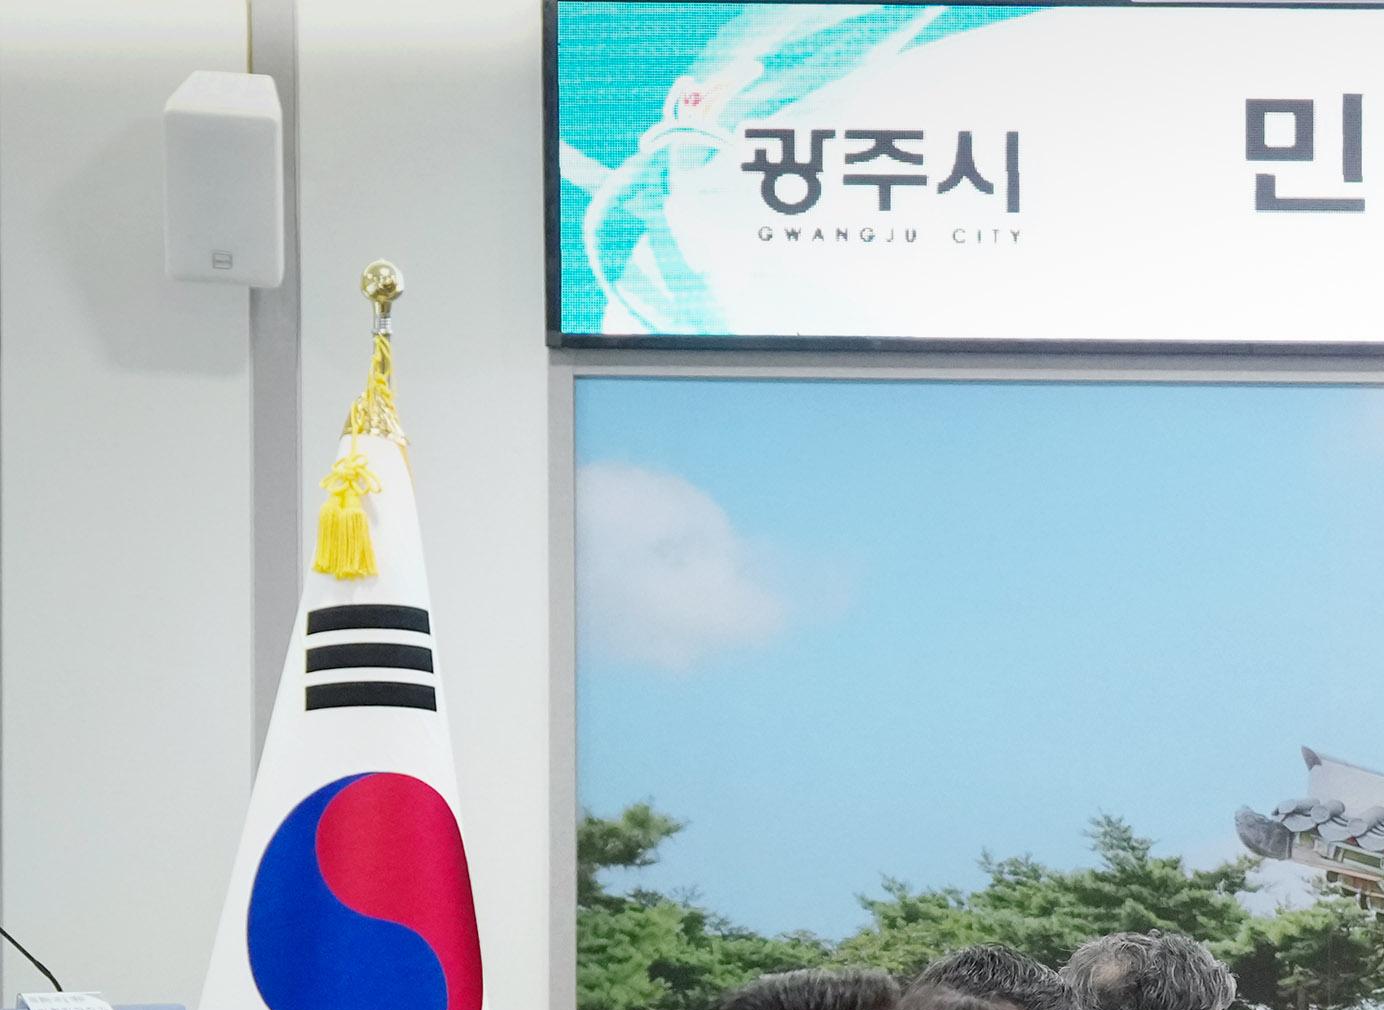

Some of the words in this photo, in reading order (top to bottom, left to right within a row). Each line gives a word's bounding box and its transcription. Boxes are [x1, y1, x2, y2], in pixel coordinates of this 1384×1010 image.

[741, 128, 1020, 216] 광주시
[758, 226, 918, 243] GWANGJU
[951, 229, 1023, 243] CITY
